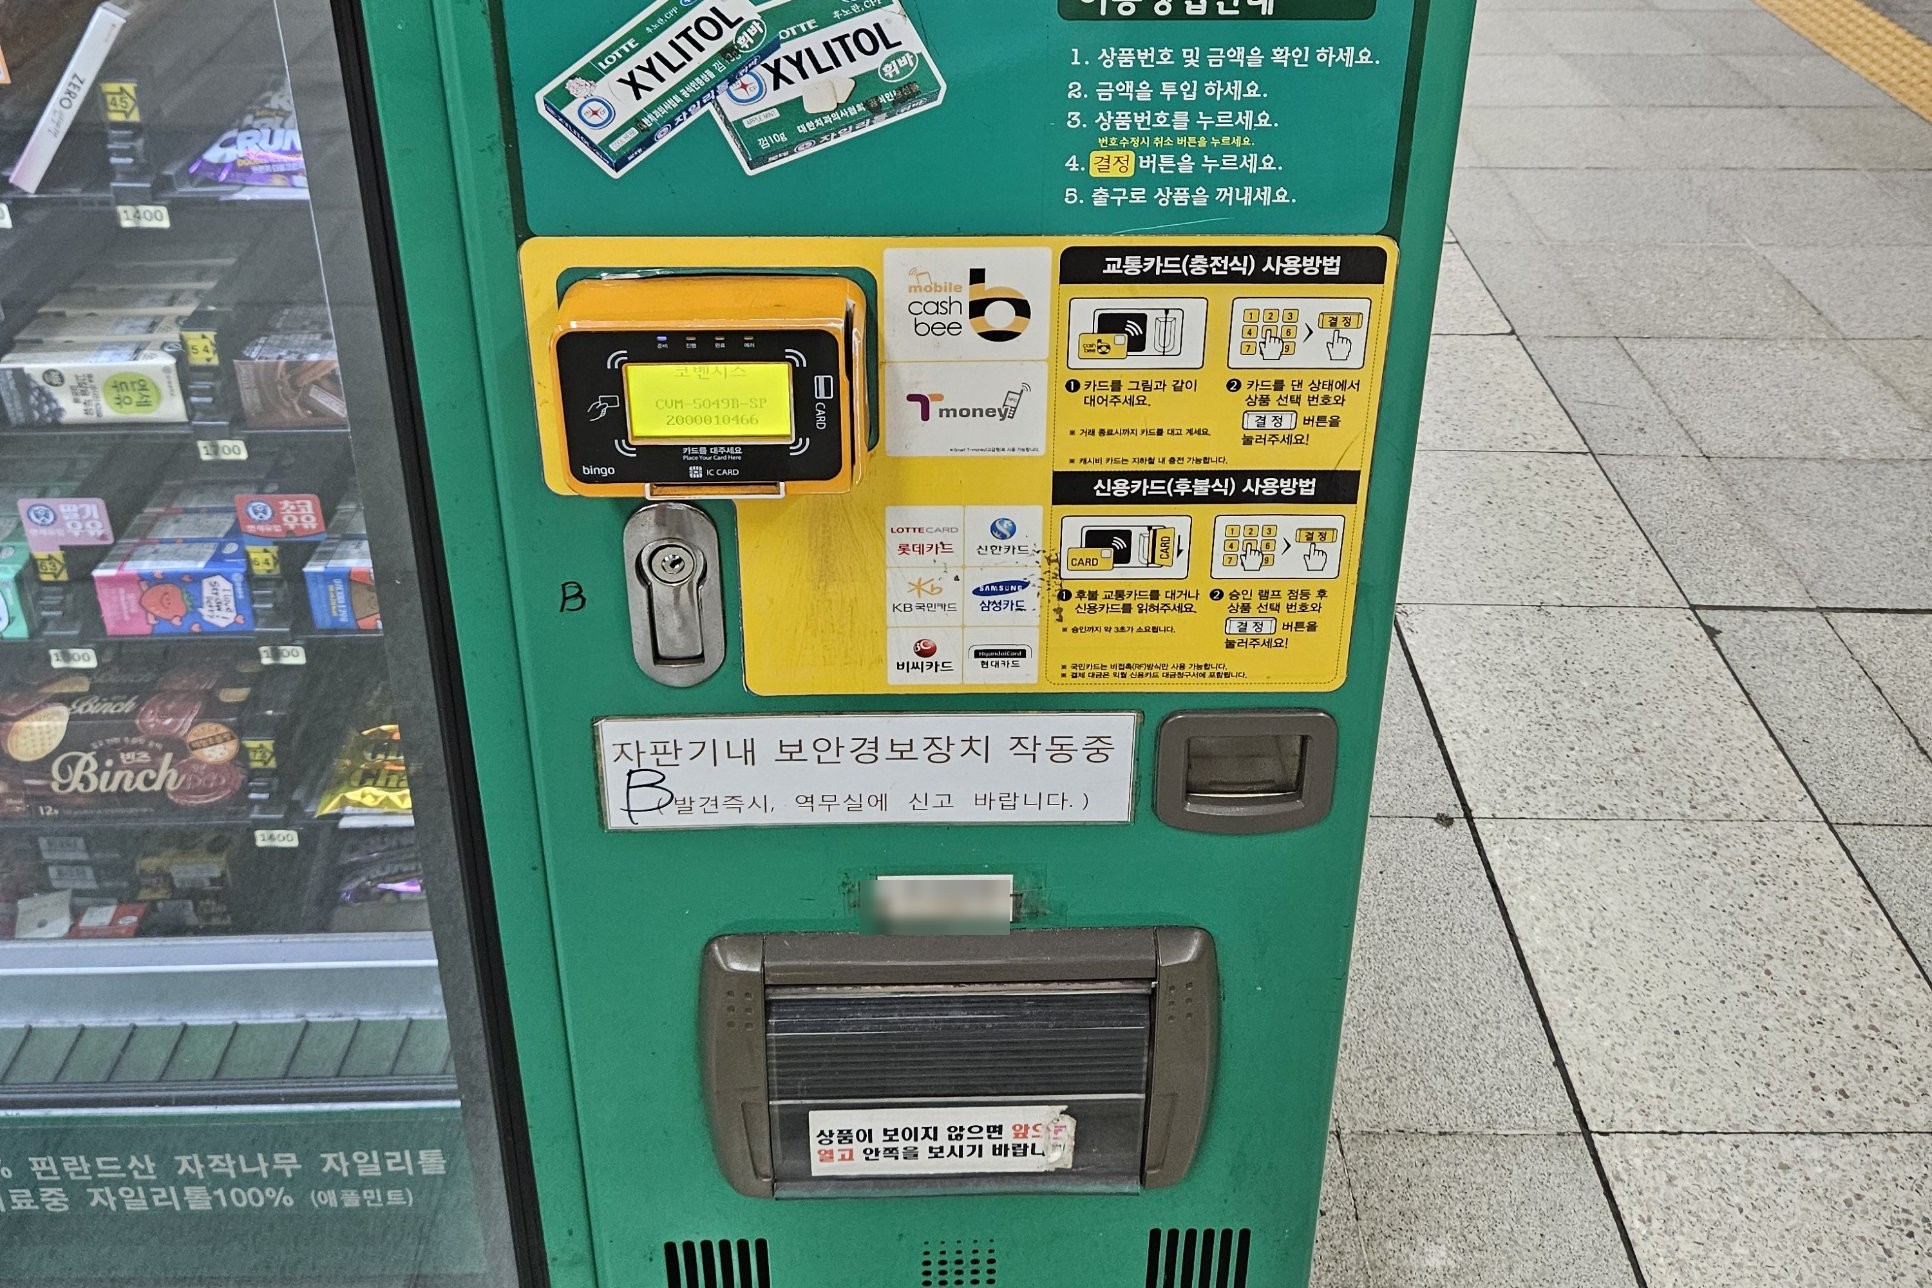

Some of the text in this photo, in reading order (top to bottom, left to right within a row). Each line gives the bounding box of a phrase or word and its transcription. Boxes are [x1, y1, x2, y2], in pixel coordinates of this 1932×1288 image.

[736, 20, 765, 49] 휘바
[597, 37, 640, 70] LOTTE
[616, 6, 745, 101] XYLITOL
[761, 22, 903, 91] XYLITOL
[1098, 47, 1175, 68] 상품번호
[1182, 47, 1201, 69] 및
[1207, 47, 1265, 68] 금액을
[1270, 46, 1310, 68] 확인
[1316, 46, 1380, 68] 하세요.
[880, 54, 916, 80] 휘바
[59, 72, 86, 110] ZERO
[1096, 80, 1152, 101] 금액을
[1159, 80, 1199, 101] 투입
[1204, 80, 1269, 101] 하세요.
[110, 97, 129, 108] 45
[1095, 110, 1190, 132] 상품번호를
[1196, 110, 1280, 130] 누르세요.
[1153, 135, 1174, 148] 취소
[1176, 136, 1208, 148] 버튼을
[1210, 136, 1256, 148] 누르세요.
[1093, 154, 1131, 174] 결정
[1138, 153, 1195, 174] 버튼을
[1201, 153, 1283, 173] 누르세요.
[1091, 186, 1147, 207] 출구로
[1153, 186, 1210, 207] 상품을
[1215, 186, 1297, 206] 꺼내세요.
[1102, 255, 1342, 276] 교통카드(충전식) 사용방법
[908, 281, 963, 293] mobile
[908, 296, 963, 316] cash
[914, 317, 963, 336] bee
[1084, 379, 1197, 392] 카드를 그림과 같이
[1246, 378, 1361, 392] 카드를 댄 상태에서
[1084, 394, 1151, 408] 대어주세요.
[1245, 394, 1346, 407] 상품 선택 번호와
[815, 402, 827, 430] CARD
[938, 406, 1010, 421] money
[1303, 414, 1341, 428] 버튼을
[1080, 428, 1095, 436] 거래
[1140, 428, 1164, 437] 카드를
[1167, 428, 1183, 436] 대고
[1241, 433, 1310, 447] 눌러주세요!
[682, 446, 743, 456] 카드를 대주세요
[1105, 457, 1129, 465] 카드는
[1158, 457, 1166, 465] 내
[582, 465, 615, 477] bingo
[706, 467, 740, 477] IC CARD
[1093, 478, 1317, 497] 신용카드(후불식) 사용방법
[282, 514, 319, 529] 우유
[897, 543, 954, 556] 롯데카드
[976, 544, 1030, 556] 신한카드
[1159, 535, 1170, 560] CARD
[1071, 556, 1099, 567] CARD
[559, 581, 588, 613] B
[1075, 589, 1199, 601] 후불 교통카드를 대거나
[1228, 588, 1328, 601] 승인 램프 점등 후
[892, 602, 957, 613] KB 국민카드
[979, 600, 1027, 612] 삼성카드
[1075, 603, 1133, 615] 신용카드를
[1227, 602, 1322, 615] 상품 선택 번호와
[1282, 620, 1318, 632] 버튼을
[1225, 637, 1289, 650] 눌러주세요!
[896, 661, 954, 673] 비씨카드
[980, 660, 1021, 669] 현대카드
[1171, 663, 1186, 671] 사용
[611, 733, 1117, 768] 자판기내 보안경보장치 작동중
[51, 750, 185, 794] Binch
[795, 791, 888, 812] 역무실에
[908, 791, 953, 811] 신고
[816, 1124, 1004, 1145] 상품이 보이지 않으면
[816, 1145, 984, 1163] 열고 안쪽을 보시기
[28, 1153, 157, 1181] 핀란드산
[174, 1151, 302, 1180] 자작나무
[320, 1149, 447, 1177] 자일리톨
[0, 1186, 413, 1212] 료중 자일리톨100% (애플민트)
